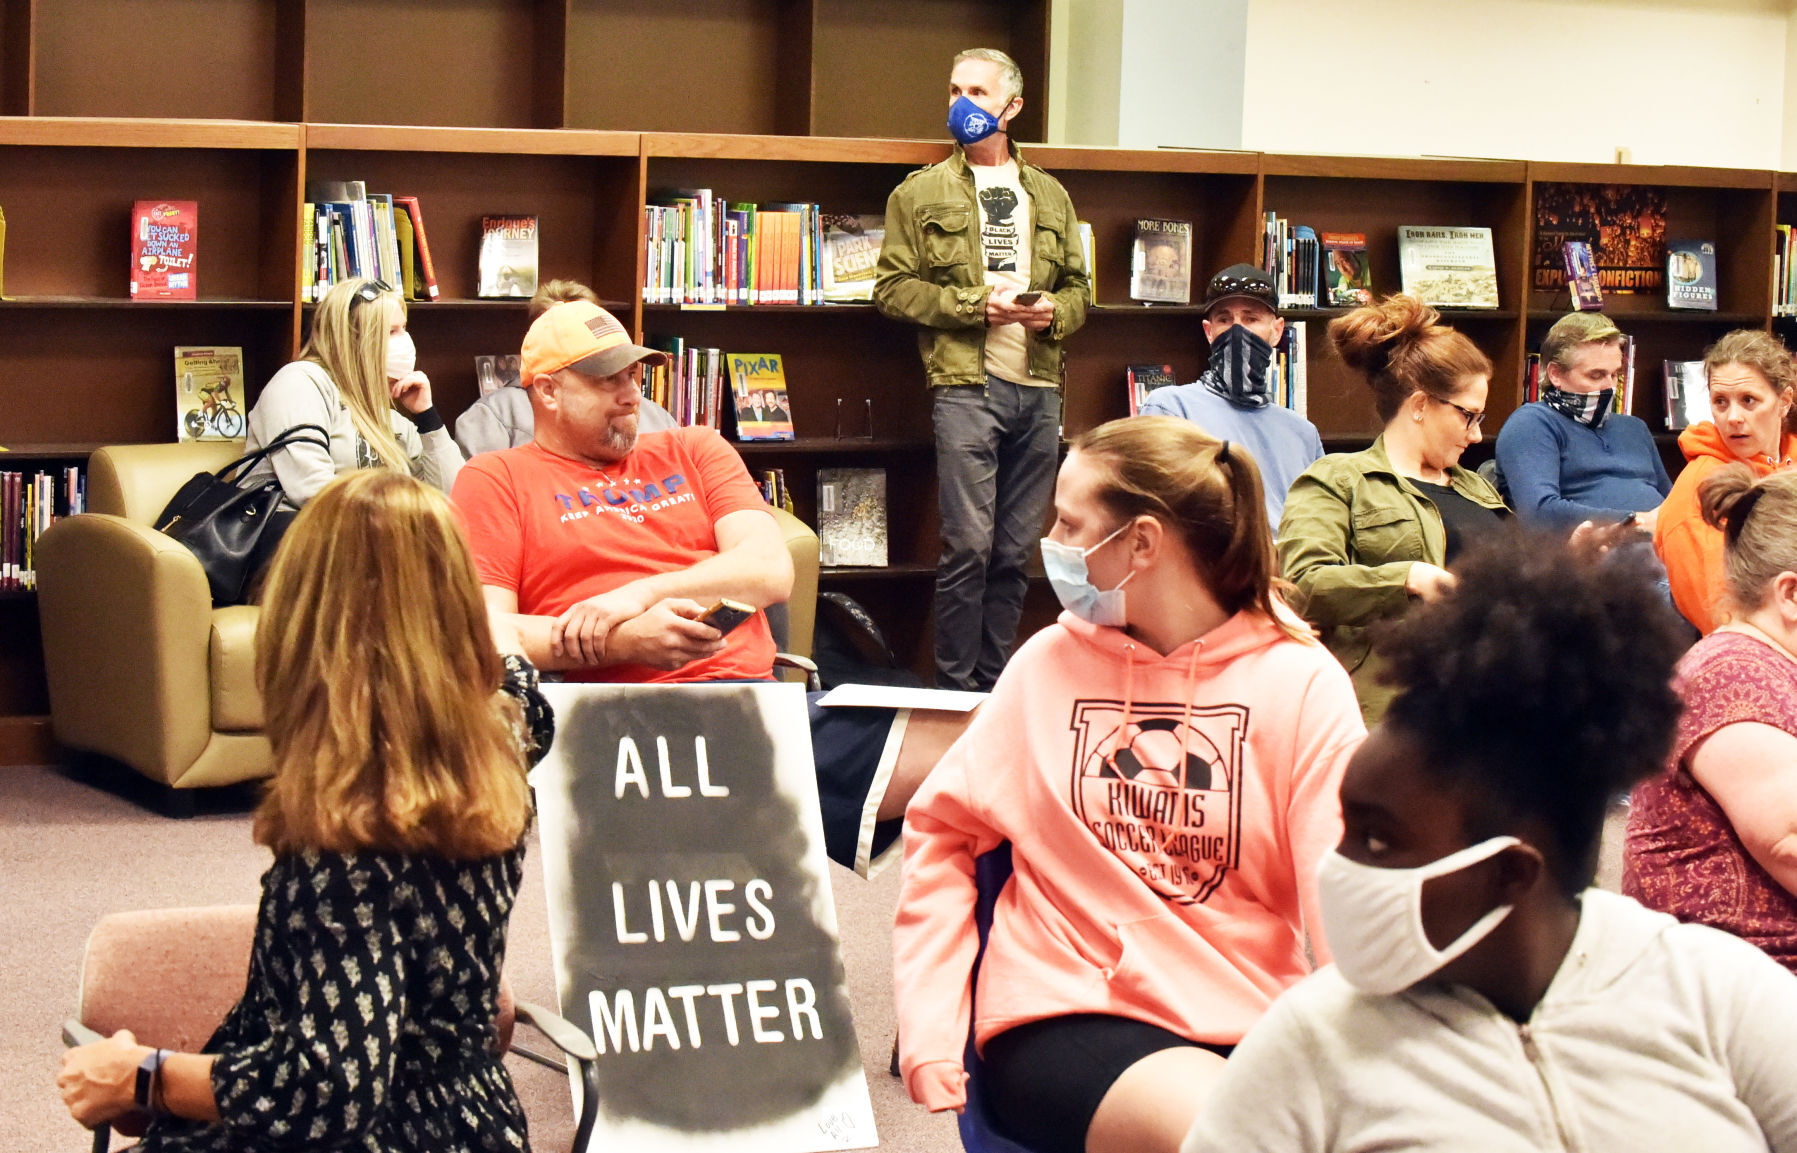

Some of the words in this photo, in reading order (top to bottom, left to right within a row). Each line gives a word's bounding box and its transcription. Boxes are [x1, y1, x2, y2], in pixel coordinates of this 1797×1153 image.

[483, 217, 535, 229] Enrique's
[1138, 220, 1160, 231] MORE
[1163, 222, 1189, 233] BONES
[158, 232, 189, 242] SUCKED
[142, 247, 182, 256] AIRPLANE
[158, 253, 194, 268] TOILET!
[1598, 269, 1662, 288] ONFICTION
[1672, 292, 1712, 300] FIGURES
[733, 356, 779, 376] PIXAR
[651, 493, 696, 511] GREAT!
[829, 537, 875, 551] FOOD
[614, 735, 730, 800] ALL
[611, 878, 776, 944] LIVES
[588, 977, 824, 1055] MATTER
